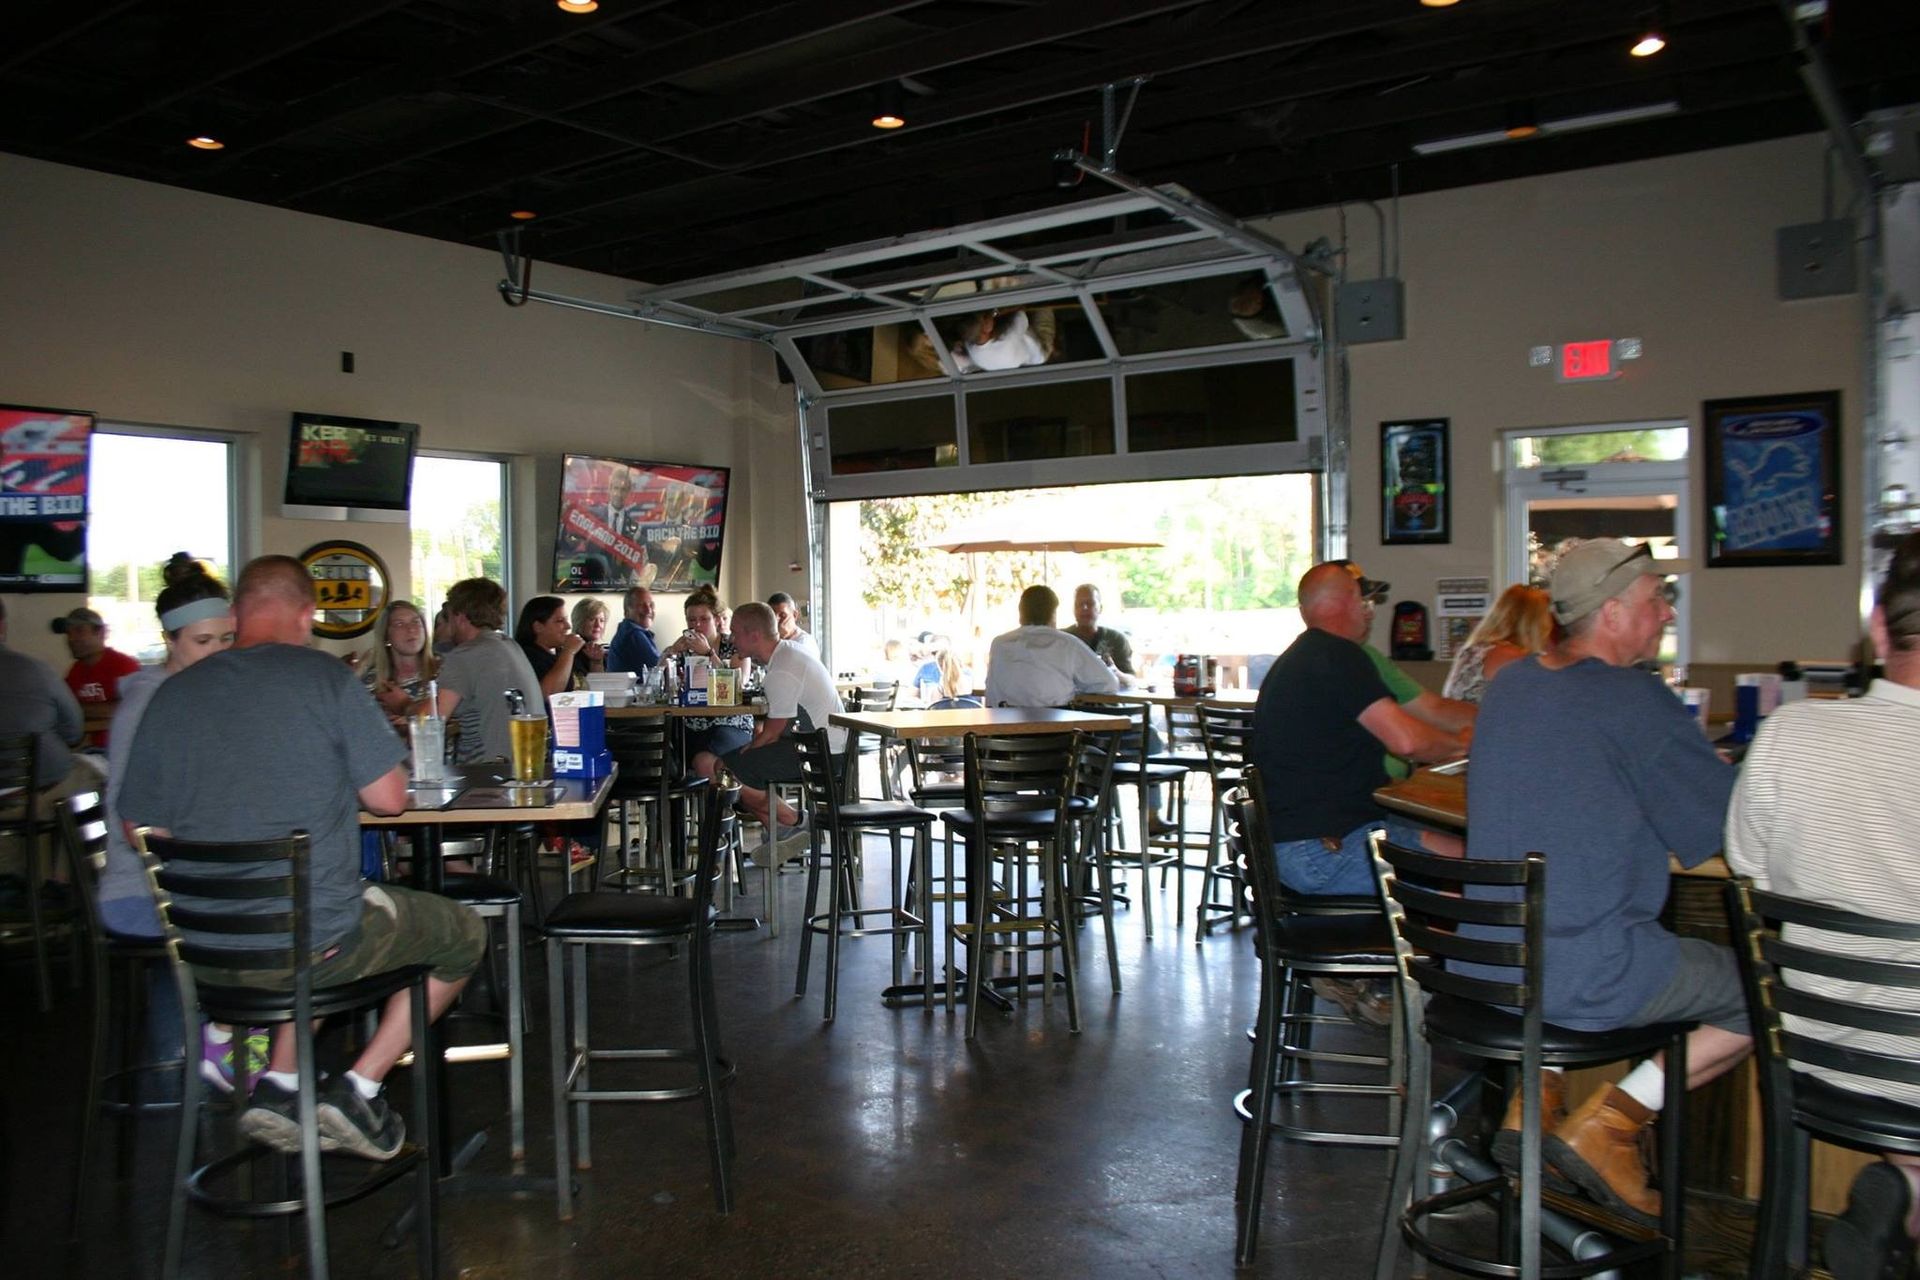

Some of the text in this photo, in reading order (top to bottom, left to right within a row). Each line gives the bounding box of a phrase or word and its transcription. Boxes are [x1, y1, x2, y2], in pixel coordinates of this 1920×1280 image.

[569, 509, 641, 564] ENGLAND 2018
[646, 527, 673, 543] BACK
[700, 524, 720, 540] BID
